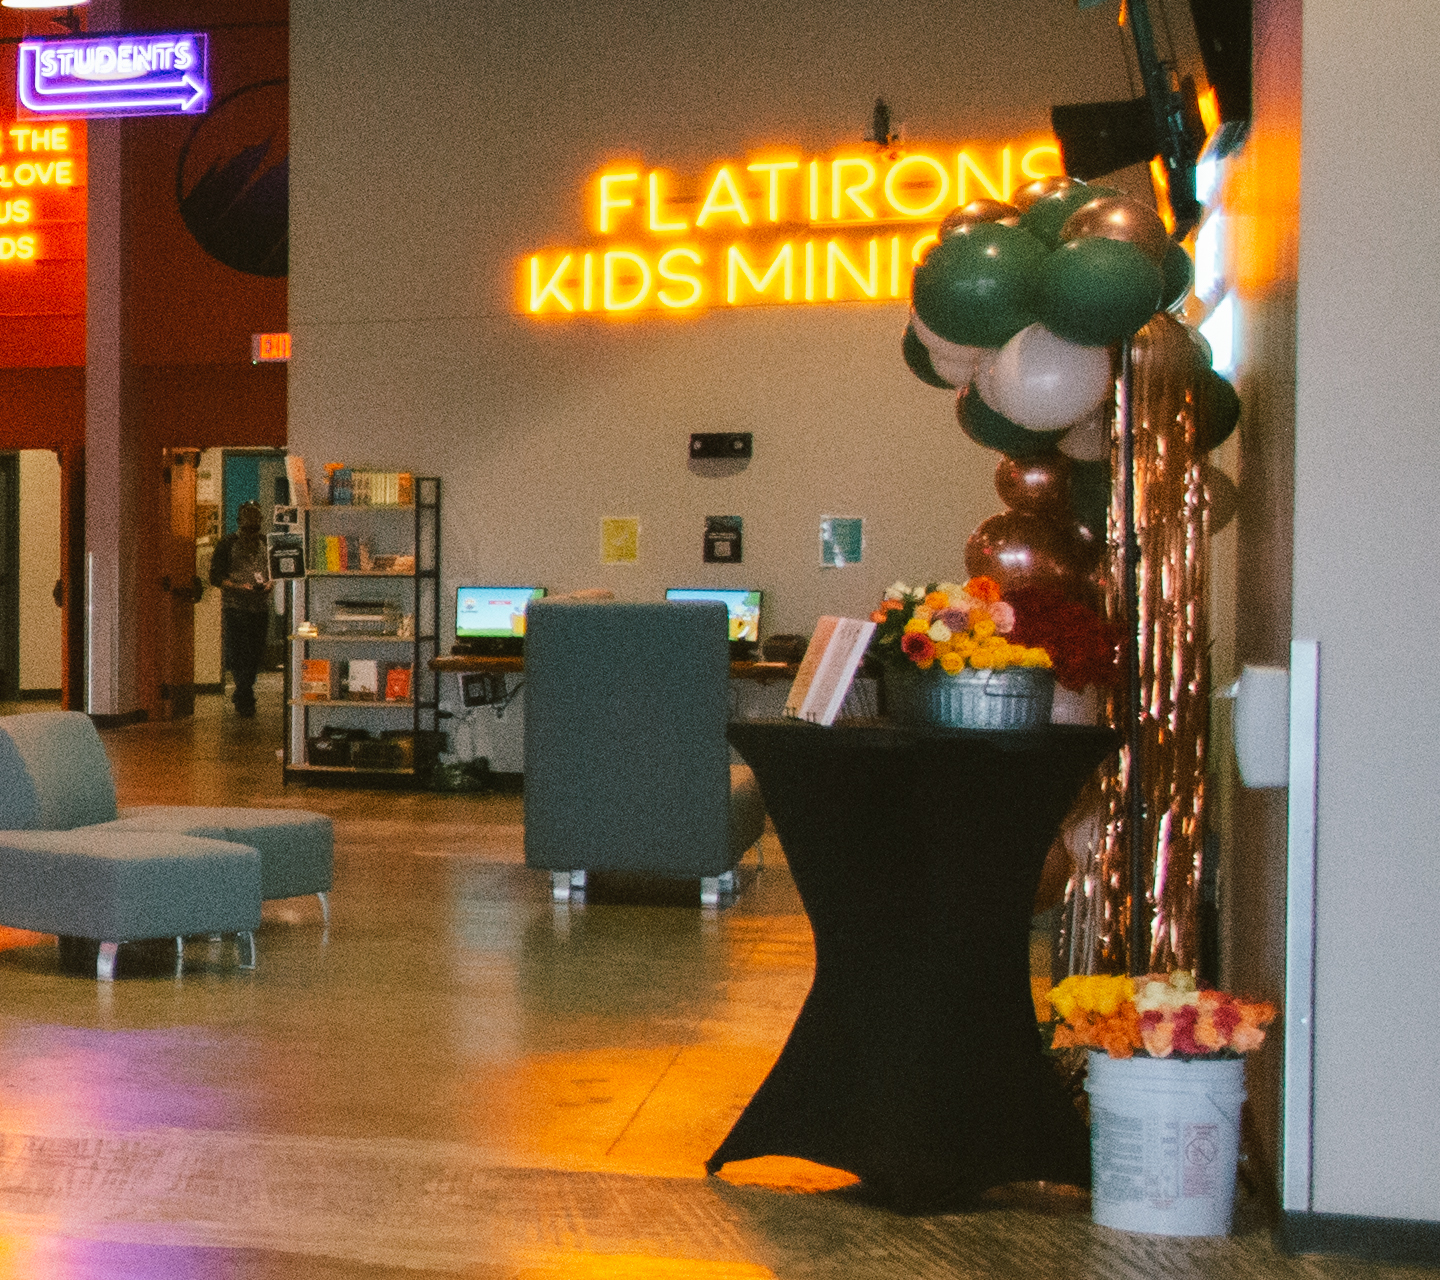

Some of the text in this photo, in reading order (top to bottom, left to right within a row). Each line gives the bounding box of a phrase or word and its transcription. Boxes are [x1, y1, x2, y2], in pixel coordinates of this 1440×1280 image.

[40, 41, 193, 77] STUDENTS
[9, 126, 68, 152] THE
[0, 160, 73, 188] LOVE
[528, 234, 937, 313] KIDS MINI
